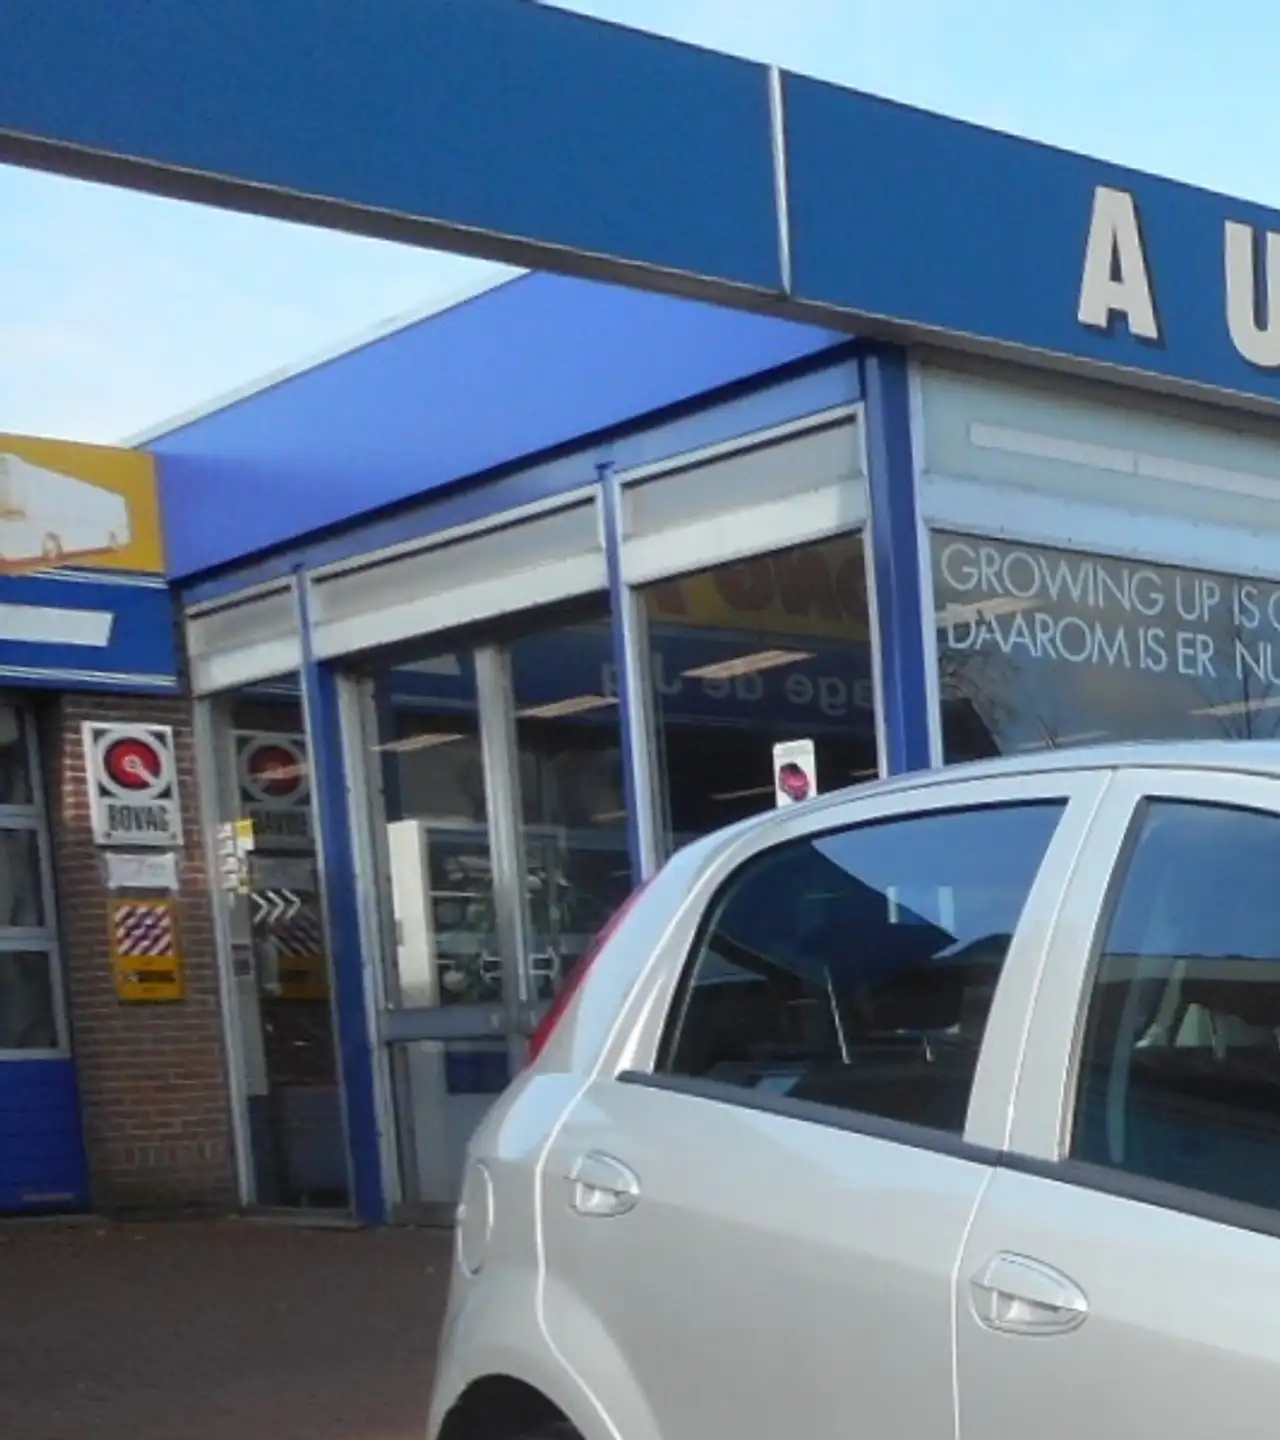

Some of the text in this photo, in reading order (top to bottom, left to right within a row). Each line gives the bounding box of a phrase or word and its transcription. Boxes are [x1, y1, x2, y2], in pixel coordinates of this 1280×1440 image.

[940, 543, 1164, 616] GROWING
[1174, 577, 1221, 624] UP
[1233, 582, 1260, 630] IS
[946, 611, 1131, 670] DAAROM
[1138, 625, 1168, 673] IS
[1176, 632, 1214, 679] ER
[107, 803, 171, 833] BOVAG
